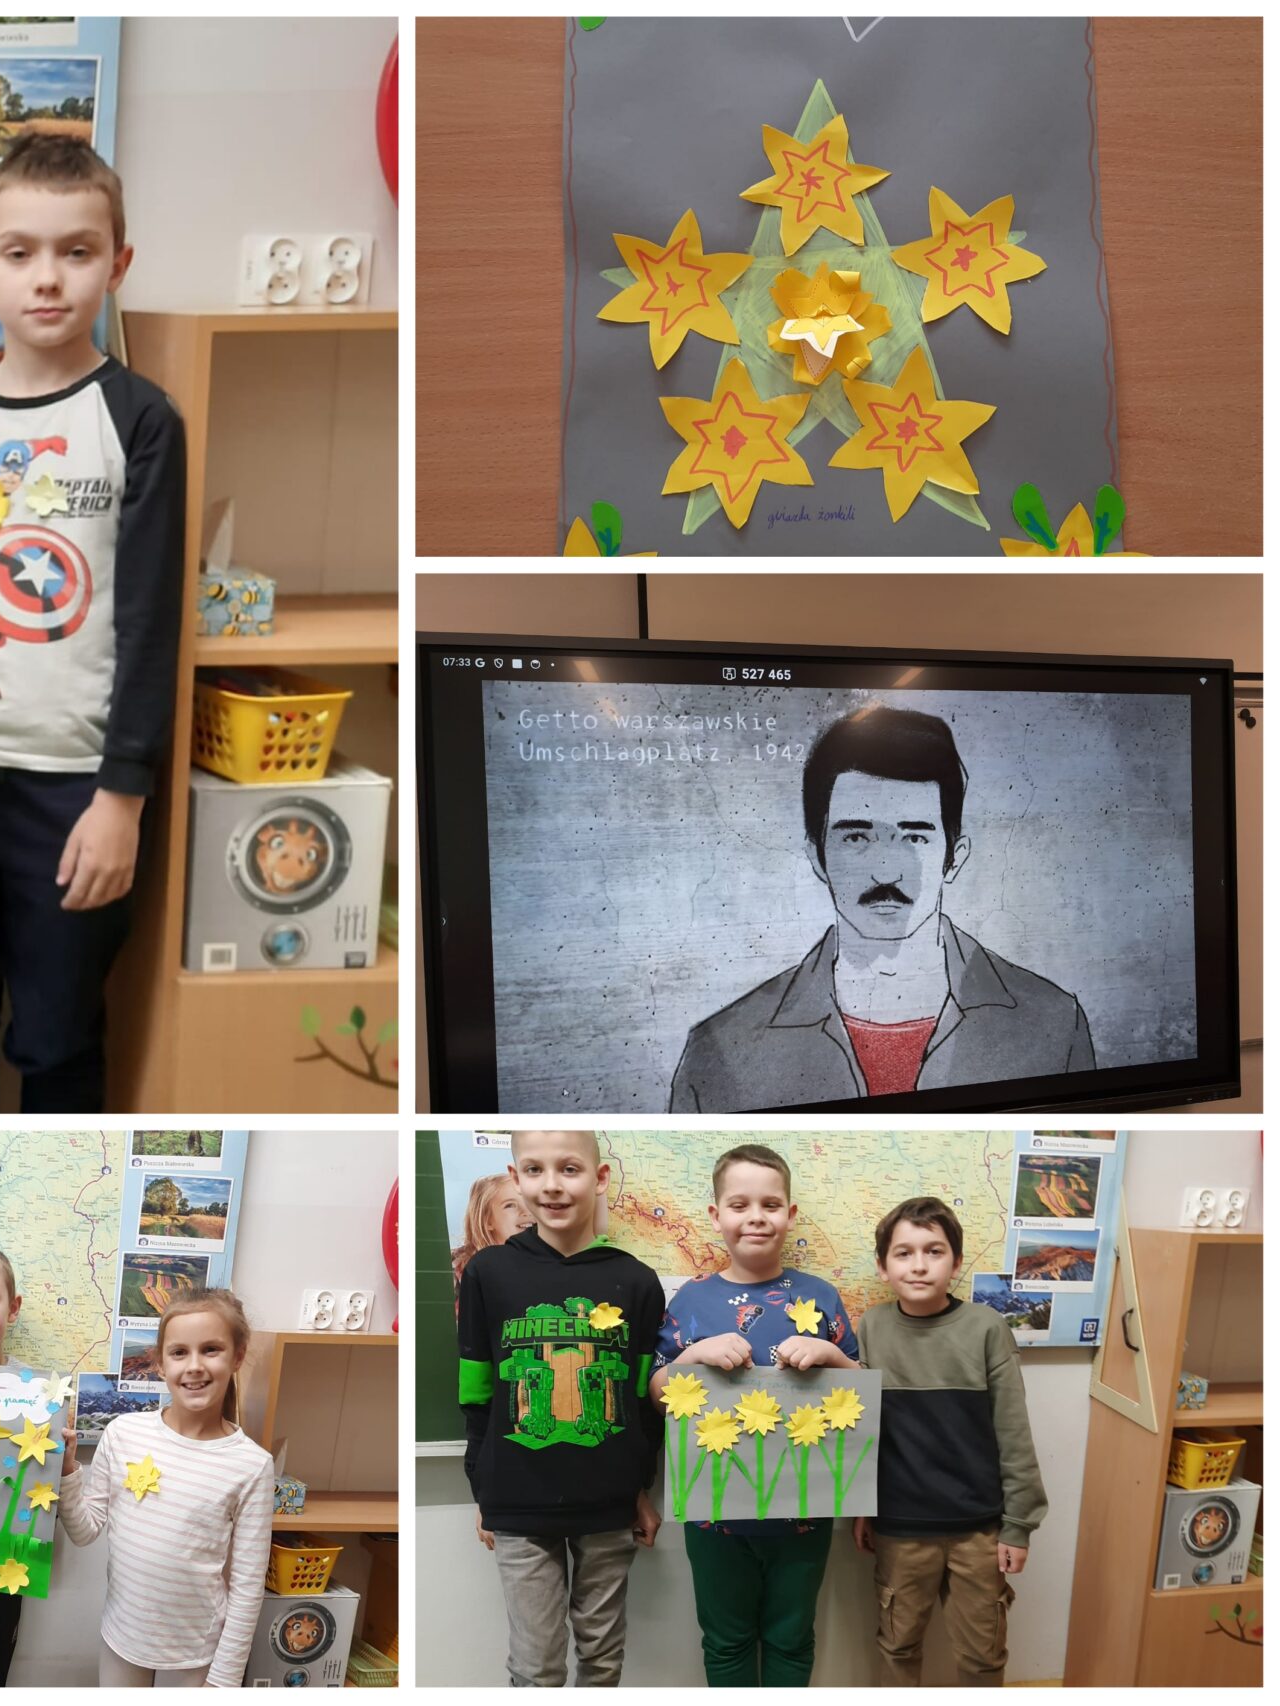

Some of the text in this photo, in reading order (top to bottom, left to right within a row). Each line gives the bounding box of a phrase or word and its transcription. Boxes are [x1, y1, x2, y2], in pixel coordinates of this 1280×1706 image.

[442, 657, 471, 667] 07:33
[741, 668, 792, 680] 527 465
[519, 709, 777, 731] Getto warszawskie
[752, 743, 806, 762] 1942
